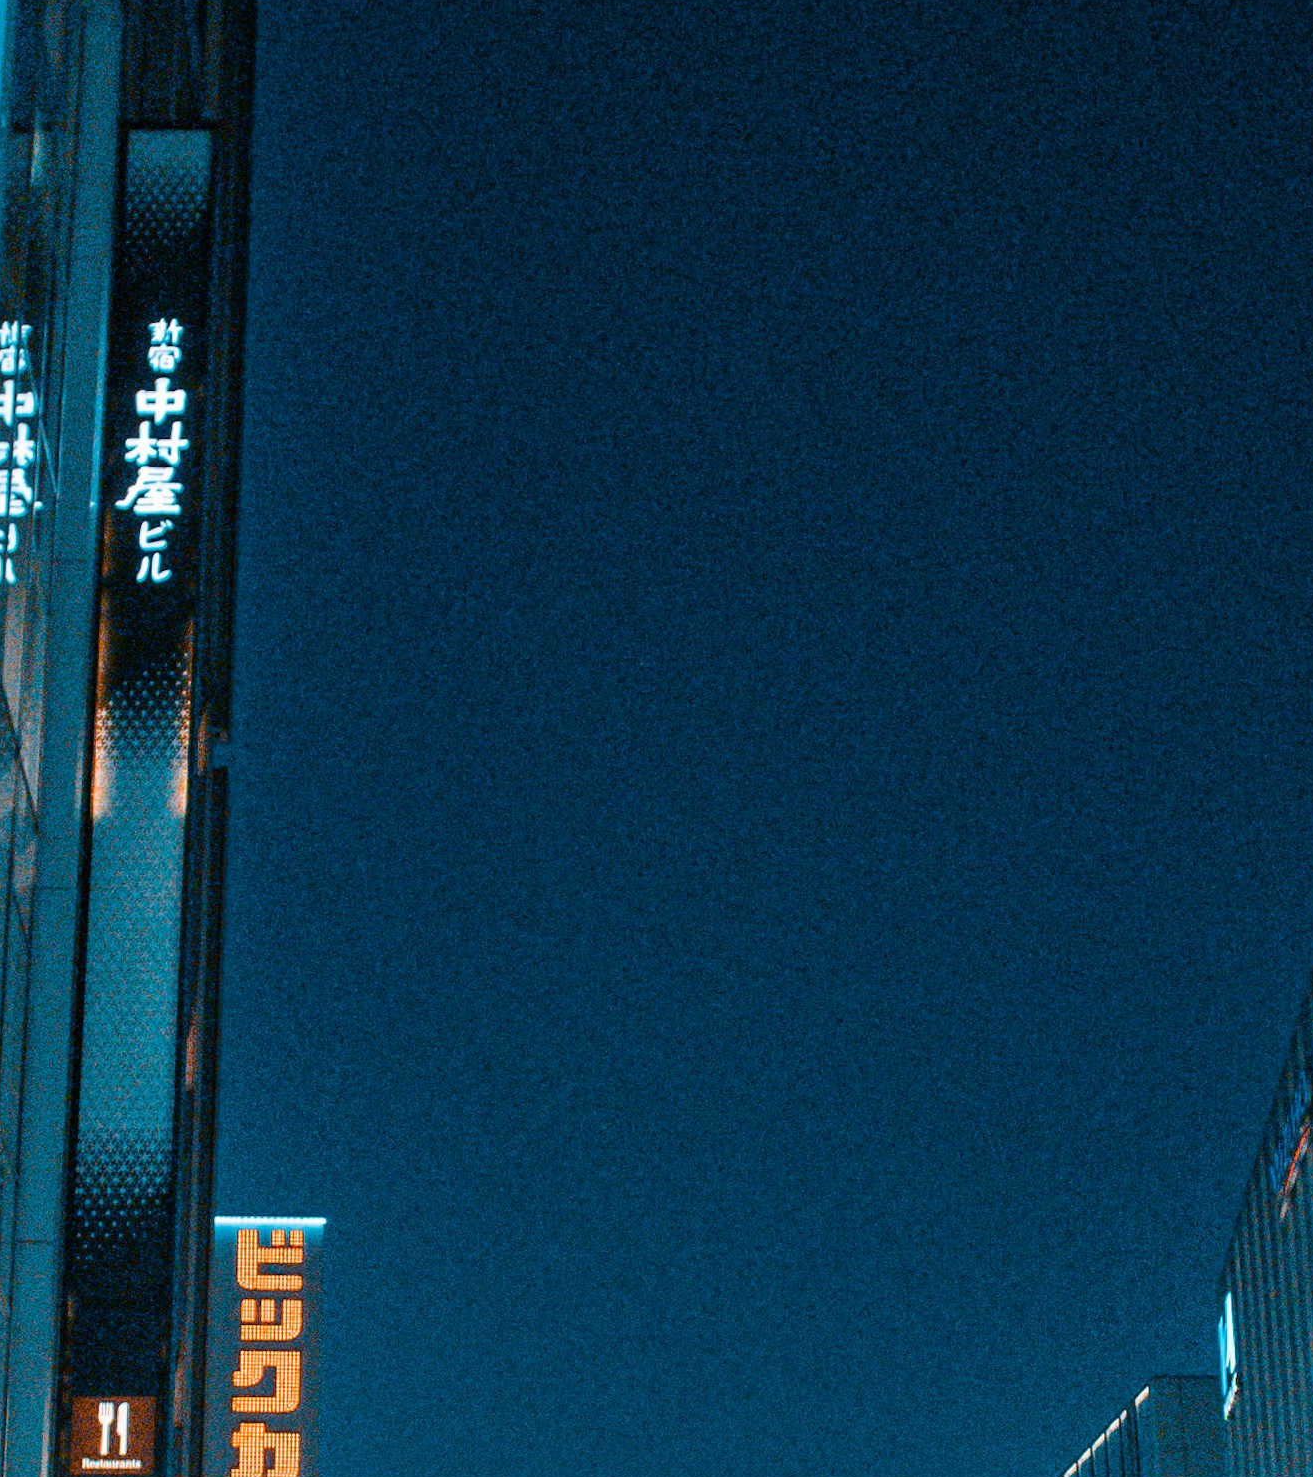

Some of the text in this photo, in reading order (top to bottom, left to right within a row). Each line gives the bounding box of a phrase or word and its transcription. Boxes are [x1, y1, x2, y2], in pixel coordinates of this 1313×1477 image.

[118, 317, 190, 584] 新宿中村屋ビル
